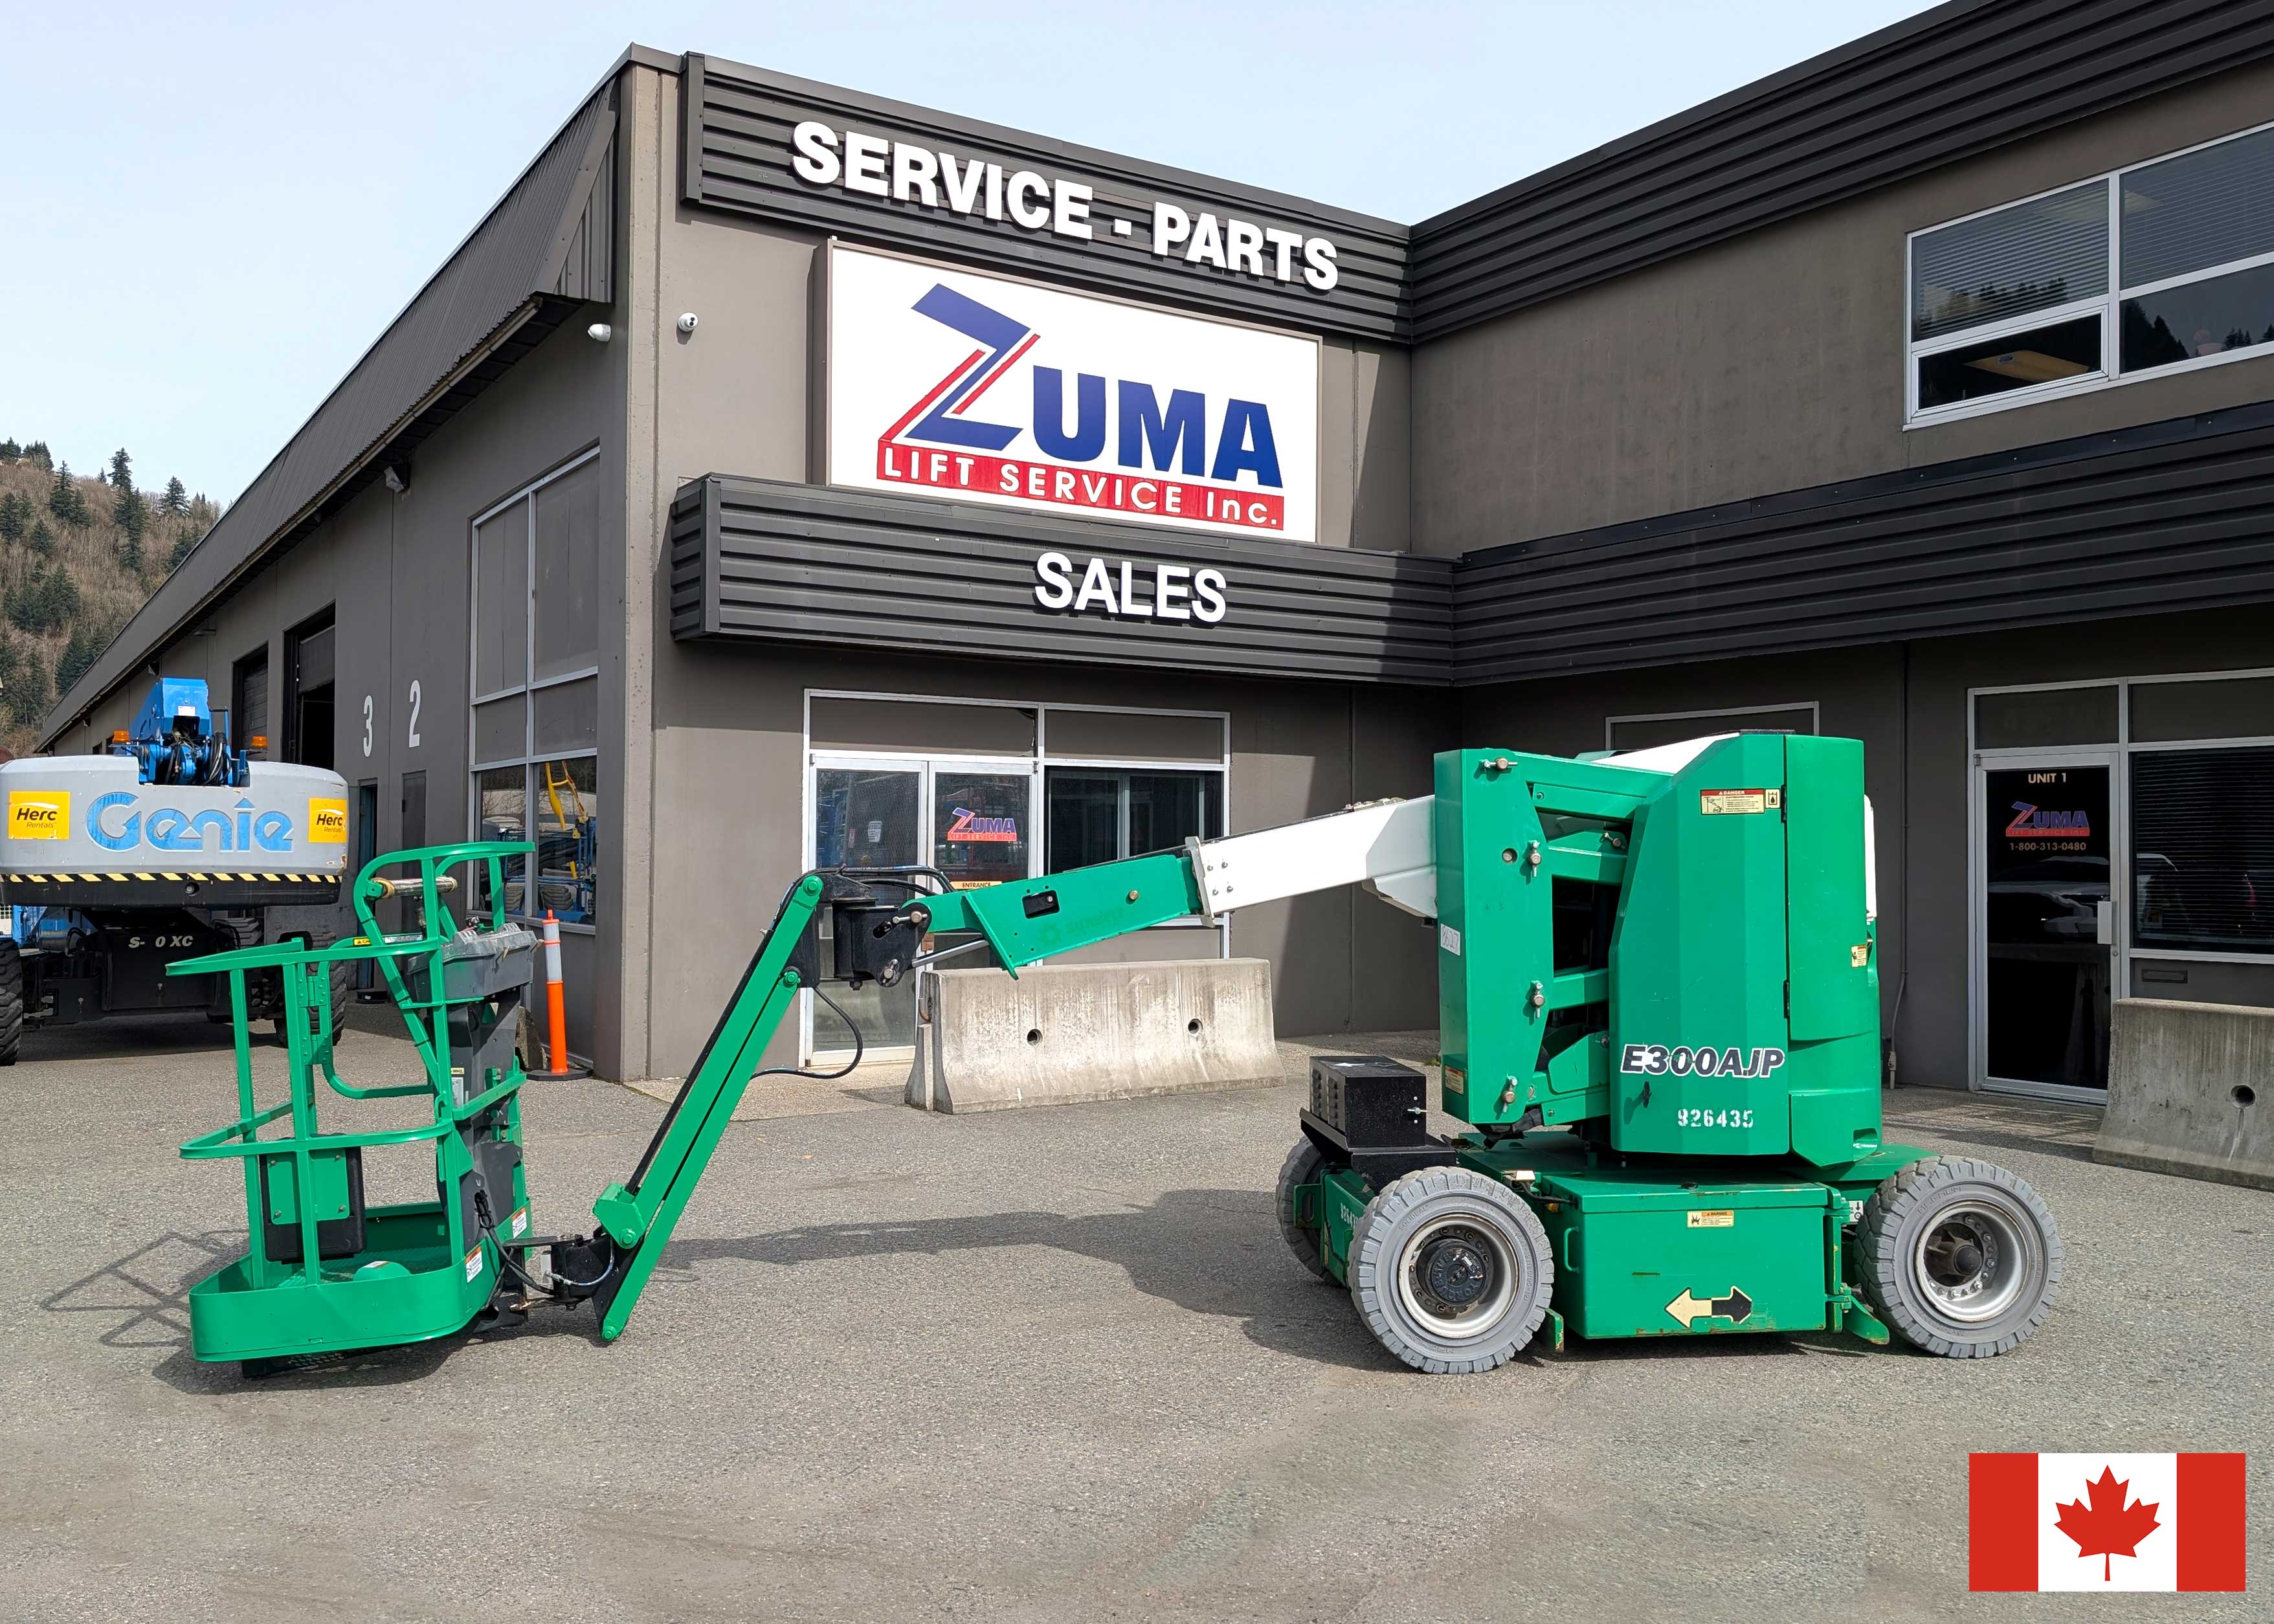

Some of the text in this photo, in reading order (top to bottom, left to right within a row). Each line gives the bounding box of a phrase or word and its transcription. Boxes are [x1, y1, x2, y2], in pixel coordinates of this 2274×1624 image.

[793, 121, 1093, 240] SERVICE
[1153, 201, 1339, 290] PARTS
[906, 284, 1283, 489] ZUMA
[884, 447, 1278, 526] LIFT SERVICE Inc.
[1035, 552, 1227, 623] SALES
[363, 695, 373, 757] 3
[408, 680, 421, 748] 2
[2028, 773, 2067, 783] UNIT 1
[16, 808, 58, 821] Herc
[85, 792, 293, 852] Genie
[316, 814, 343, 826] Herc
[950, 807, 1016, 834] ZUMA
[2011, 801, 2090, 829] ZUMA
[2010, 842, 2086, 851] 1-800-313-0480
[169, 935, 194, 947] XC
[1620, 1043, 1785, 1079] E300AJP
[1677, 1108, 1754, 1129] 926435
